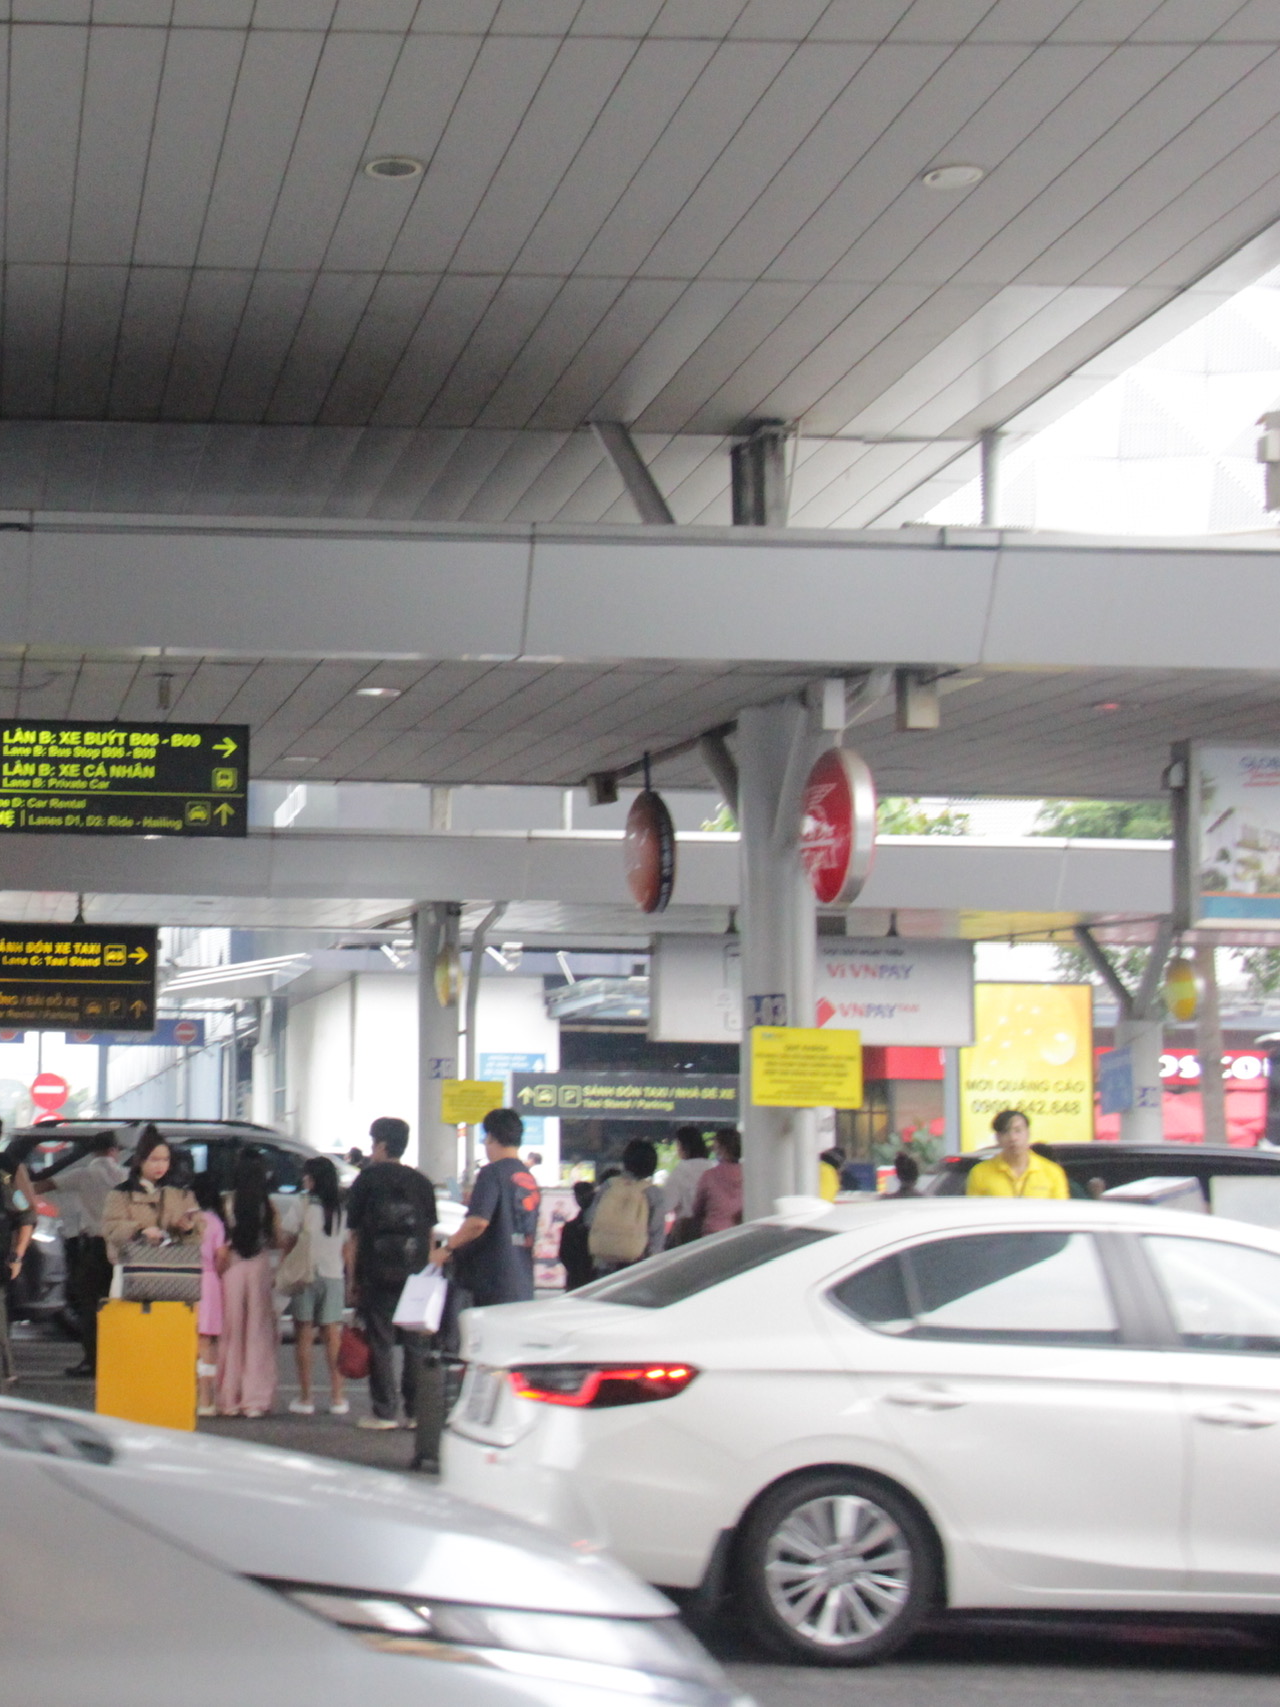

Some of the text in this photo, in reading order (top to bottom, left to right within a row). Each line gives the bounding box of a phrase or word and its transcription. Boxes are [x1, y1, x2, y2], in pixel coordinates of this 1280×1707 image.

[38, 731, 56, 744] B:
[59, 731, 81, 745] XE
[2, 745, 31, 757] Lane
[48, 745, 72, 757] Bus
[73, 746, 101, 759] Stop
[38, 764, 55, 777] B:
[59, 764, 81, 777] XE
[83, 761, 108, 778] CÁ
[2, 777, 31, 787] Lane
[47, 778, 88, 789] Private
[89, 779, 110, 789] Car
[26, 798, 48, 808] Car
[49, 798, 87, 809] Rental
[54, 942, 72, 954] XE
[73, 942, 102, 954] TAXI
[849, 963, 914, 979] VNPAY
[644, 1086, 669, 1098] TAXI
